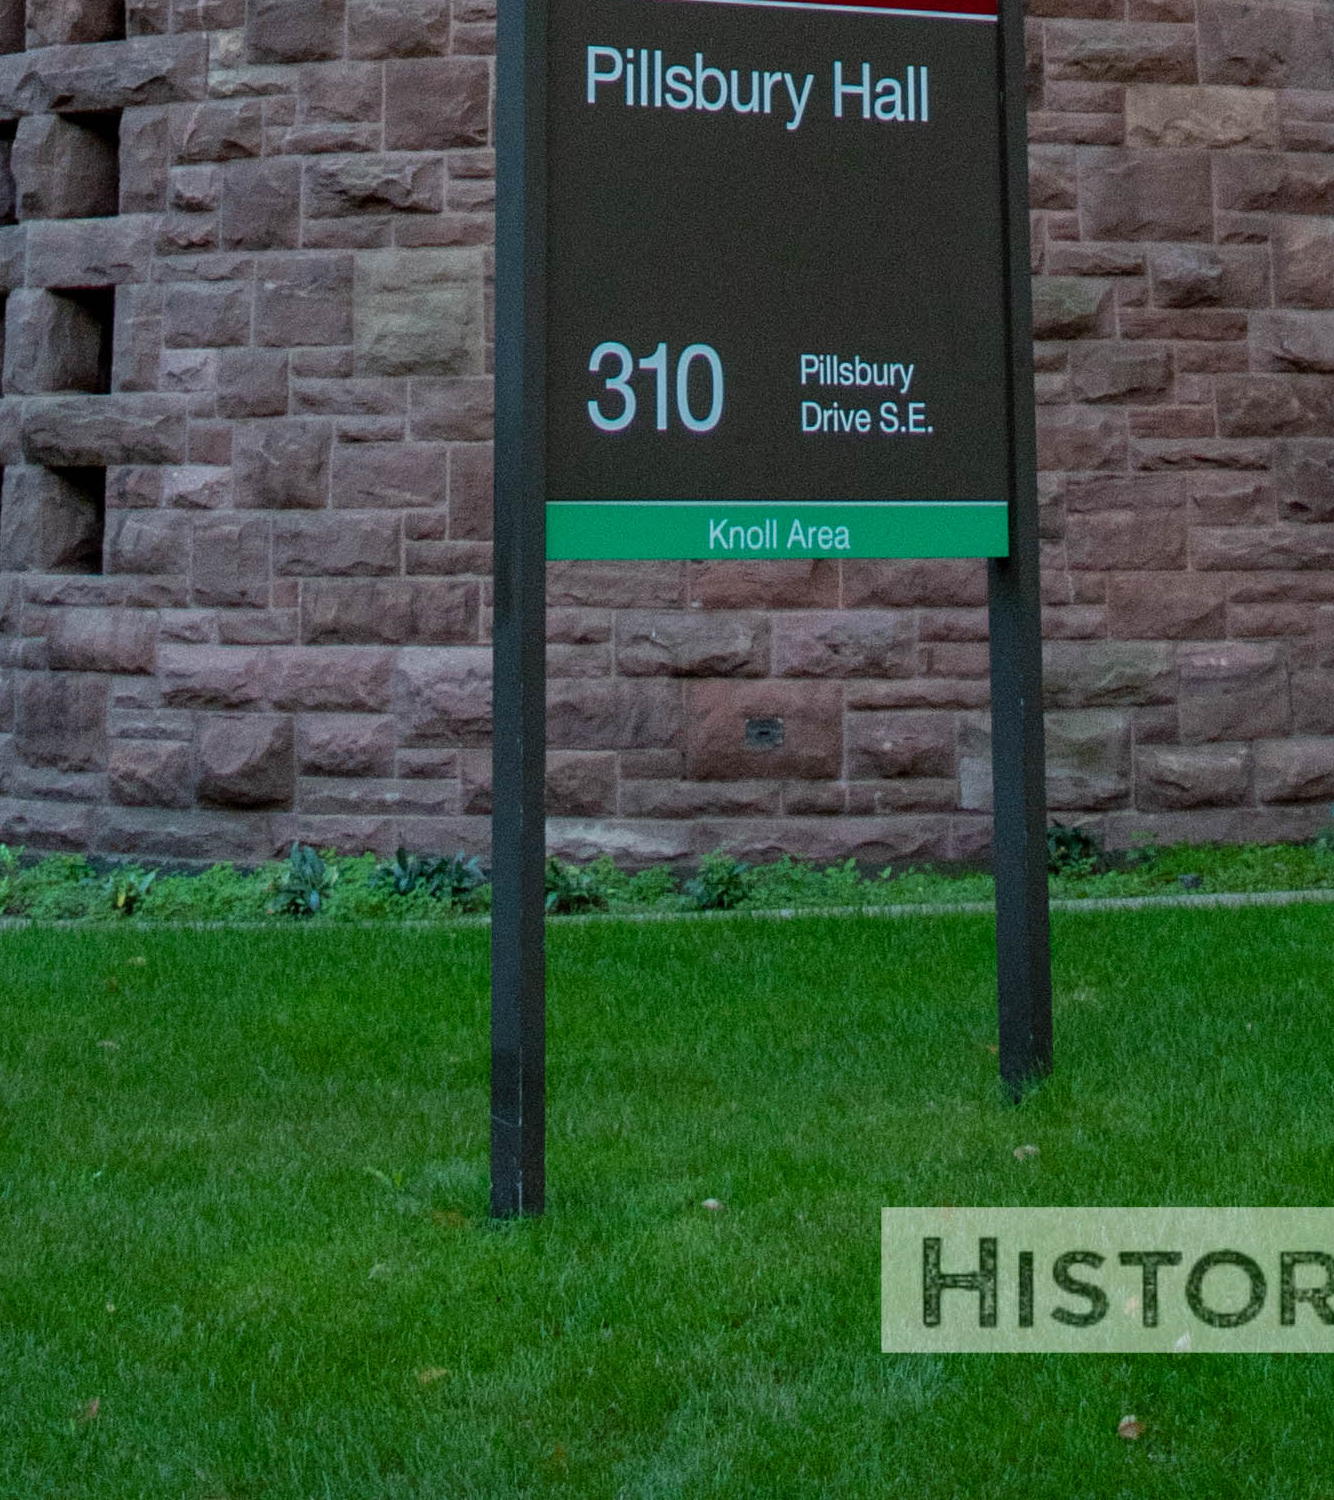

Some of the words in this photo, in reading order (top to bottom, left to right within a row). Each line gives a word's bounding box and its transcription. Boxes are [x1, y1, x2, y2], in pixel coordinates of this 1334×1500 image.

[586, 45, 815, 131] Pillsbury
[833, 60, 930, 123] Hall
[587, 341, 725, 432] 310
[800, 354, 915, 394] Pillsbury
[801, 401, 872, 433] Drive
[879, 401, 934, 434] S.E.
[709, 519, 778, 550] Knoll
[786, 519, 851, 550] Area
